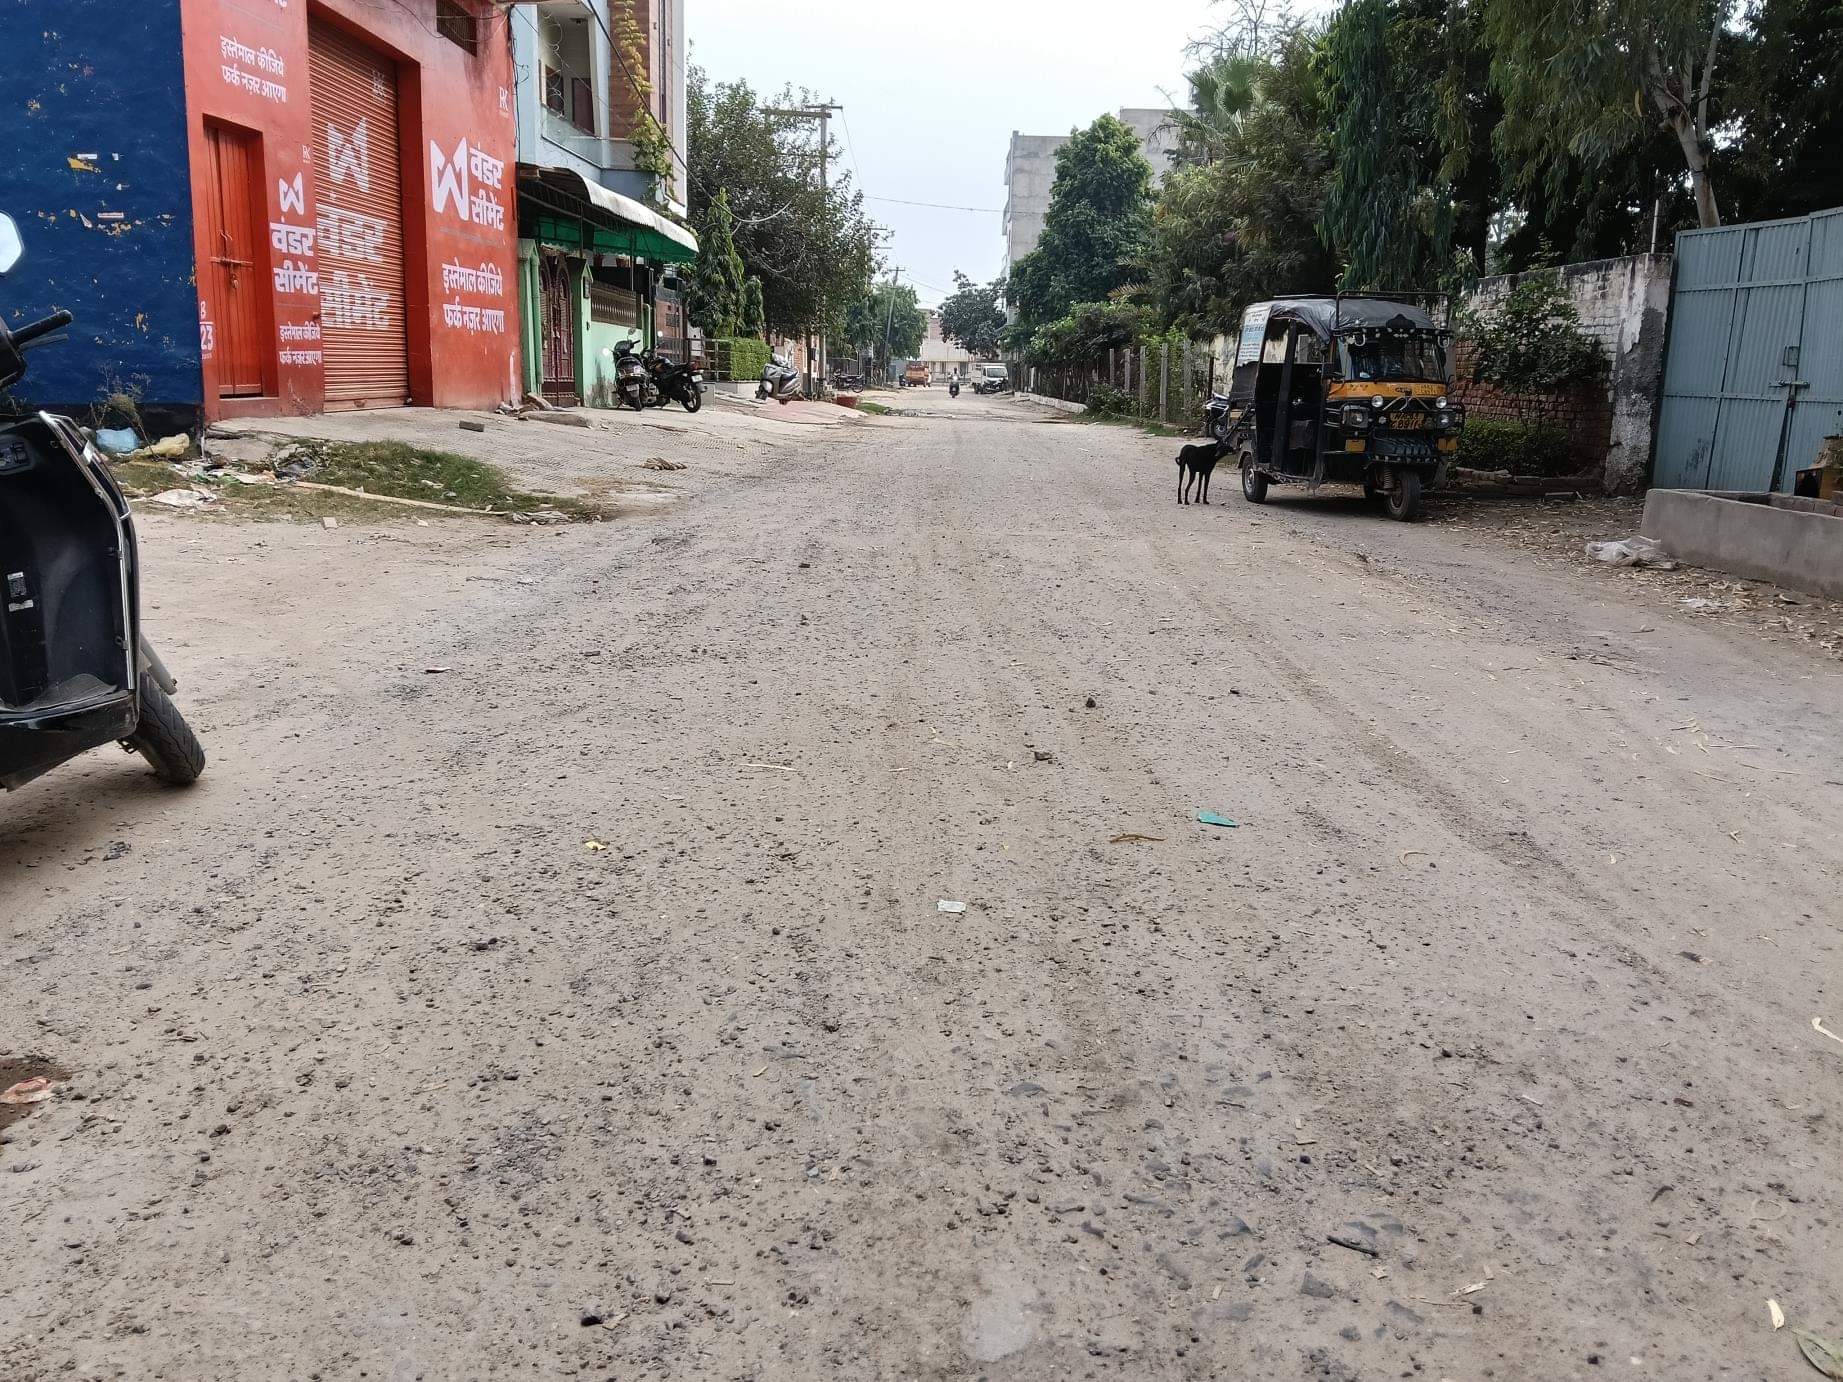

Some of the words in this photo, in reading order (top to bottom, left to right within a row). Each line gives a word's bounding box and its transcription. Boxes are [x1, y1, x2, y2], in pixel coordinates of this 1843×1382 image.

[470, 142, 504, 189] वंडर
[316, 192, 388, 263] वंडर
[471, 189, 504, 231] सीमेंट
[269, 216, 316, 256] वंडर
[273, 260, 319, 294] सीमेंट
[442, 257, 476, 294] इस्तेमाल
[320, 271, 389, 330] सीमेंट
[443, 296, 462, 328] फर्क
[481, 309, 504, 335] आएगा
